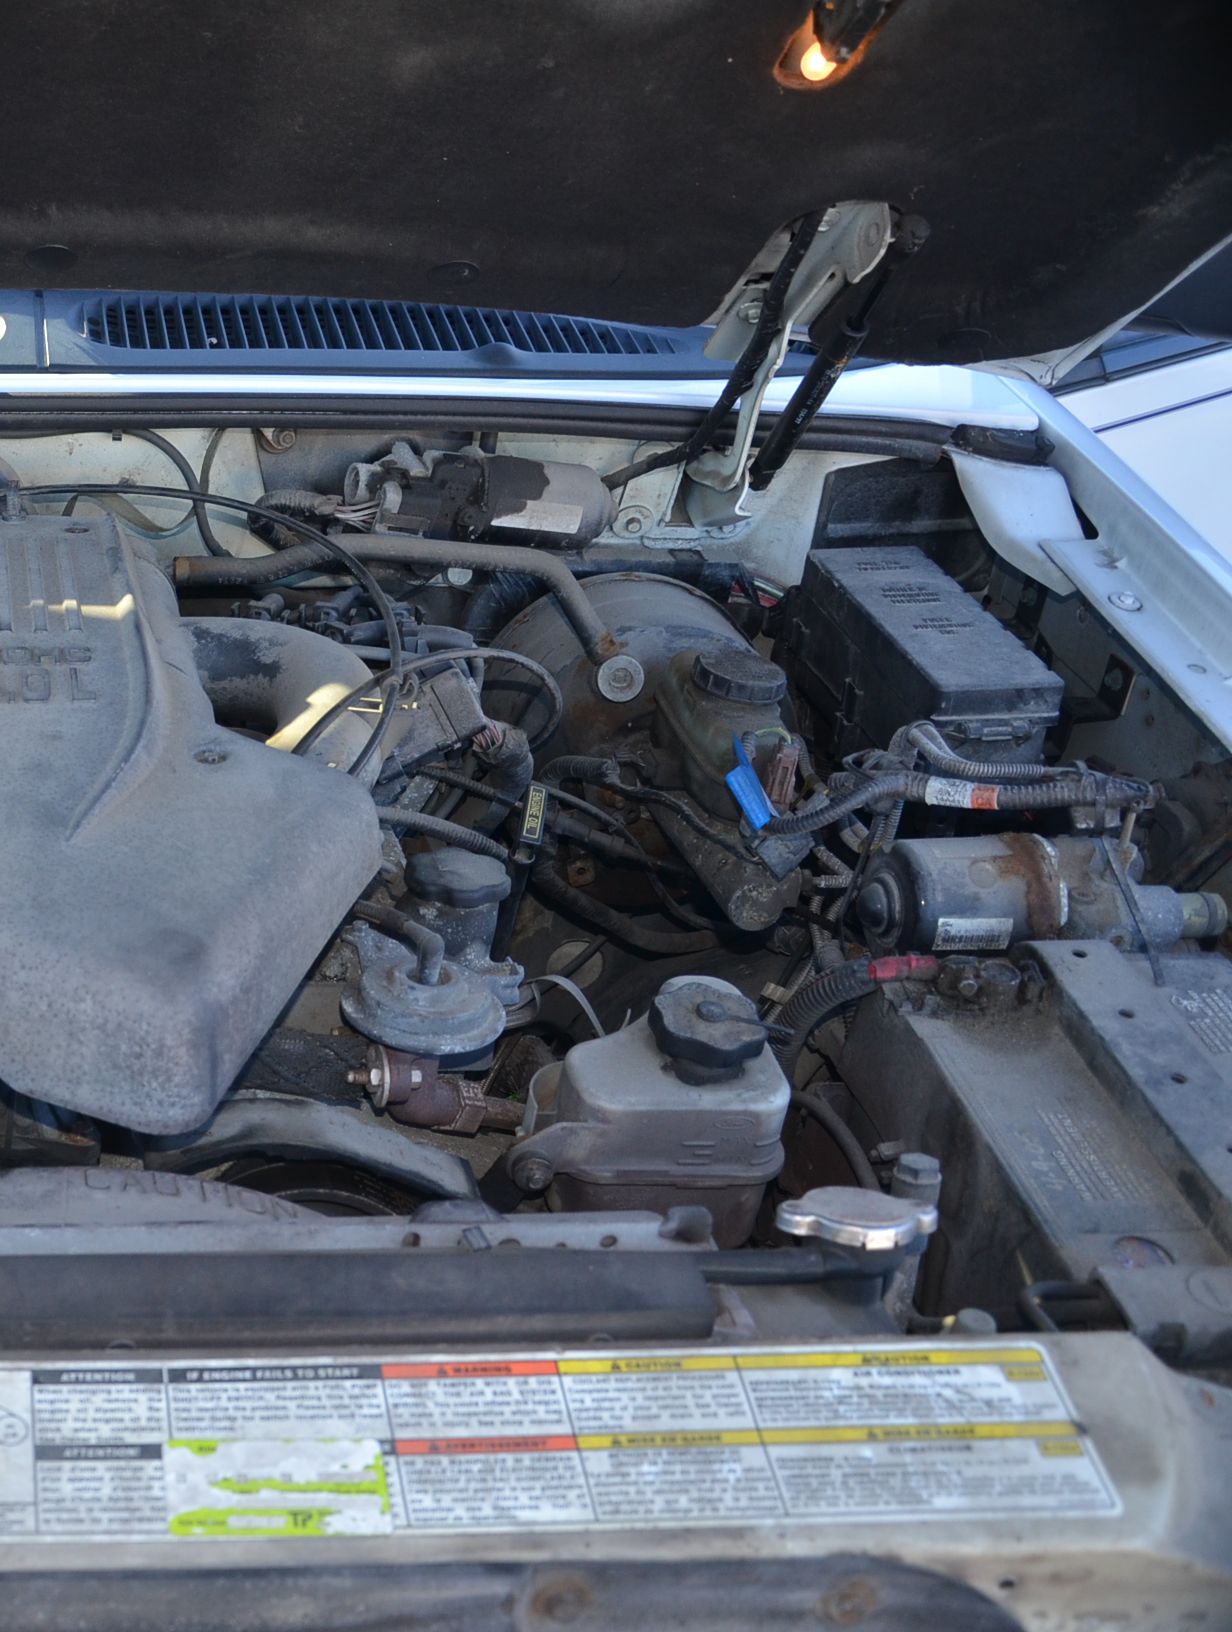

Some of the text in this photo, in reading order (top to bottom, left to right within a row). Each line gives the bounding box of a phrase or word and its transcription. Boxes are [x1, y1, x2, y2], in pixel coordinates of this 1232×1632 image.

[529, 791, 543, 817] ENGINE
[528, 817, 538, 829] OIL
[83, 1167, 299, 1221] CAUTION
[625, 1361, 683, 1369] CAUTION
[60, 1372, 135, 1382] ATTENTION
[187, 1367, 359, 1380] IF ENGINE FAILS TO START
